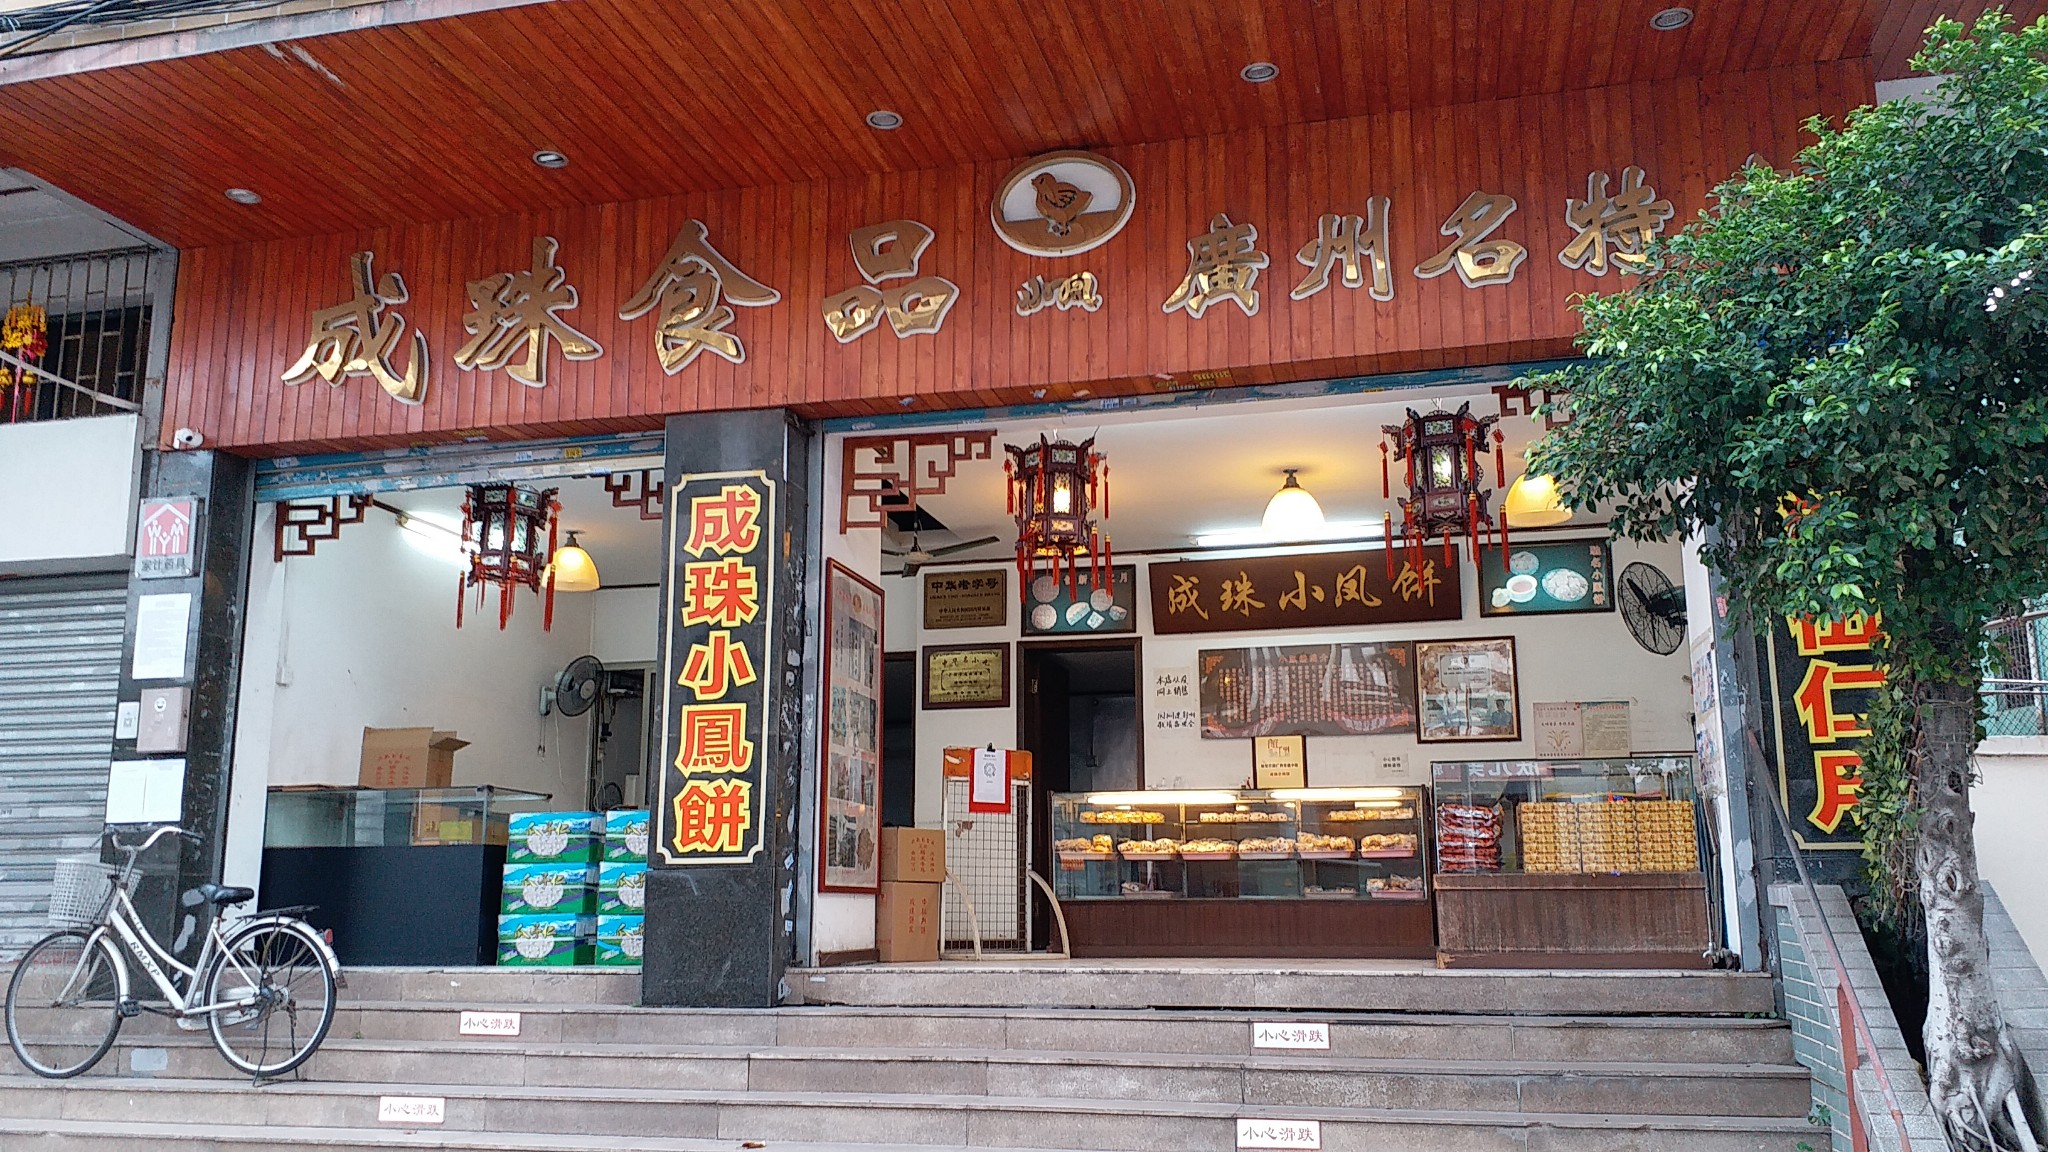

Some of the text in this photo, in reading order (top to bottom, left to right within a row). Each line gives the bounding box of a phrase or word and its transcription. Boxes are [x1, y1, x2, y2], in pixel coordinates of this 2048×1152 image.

[281, 218, 961, 406] 成珠食品
[673, 484, 761, 853] 成珠小鳳餅
[463, 1017, 516, 1030] 小心滑跌
[1258, 1028, 1325, 1043] 小心滑跌
[383, 1103, 440, 1116] 小心滑跌
[1242, 1126, 1315, 1142] 小心滑跌
